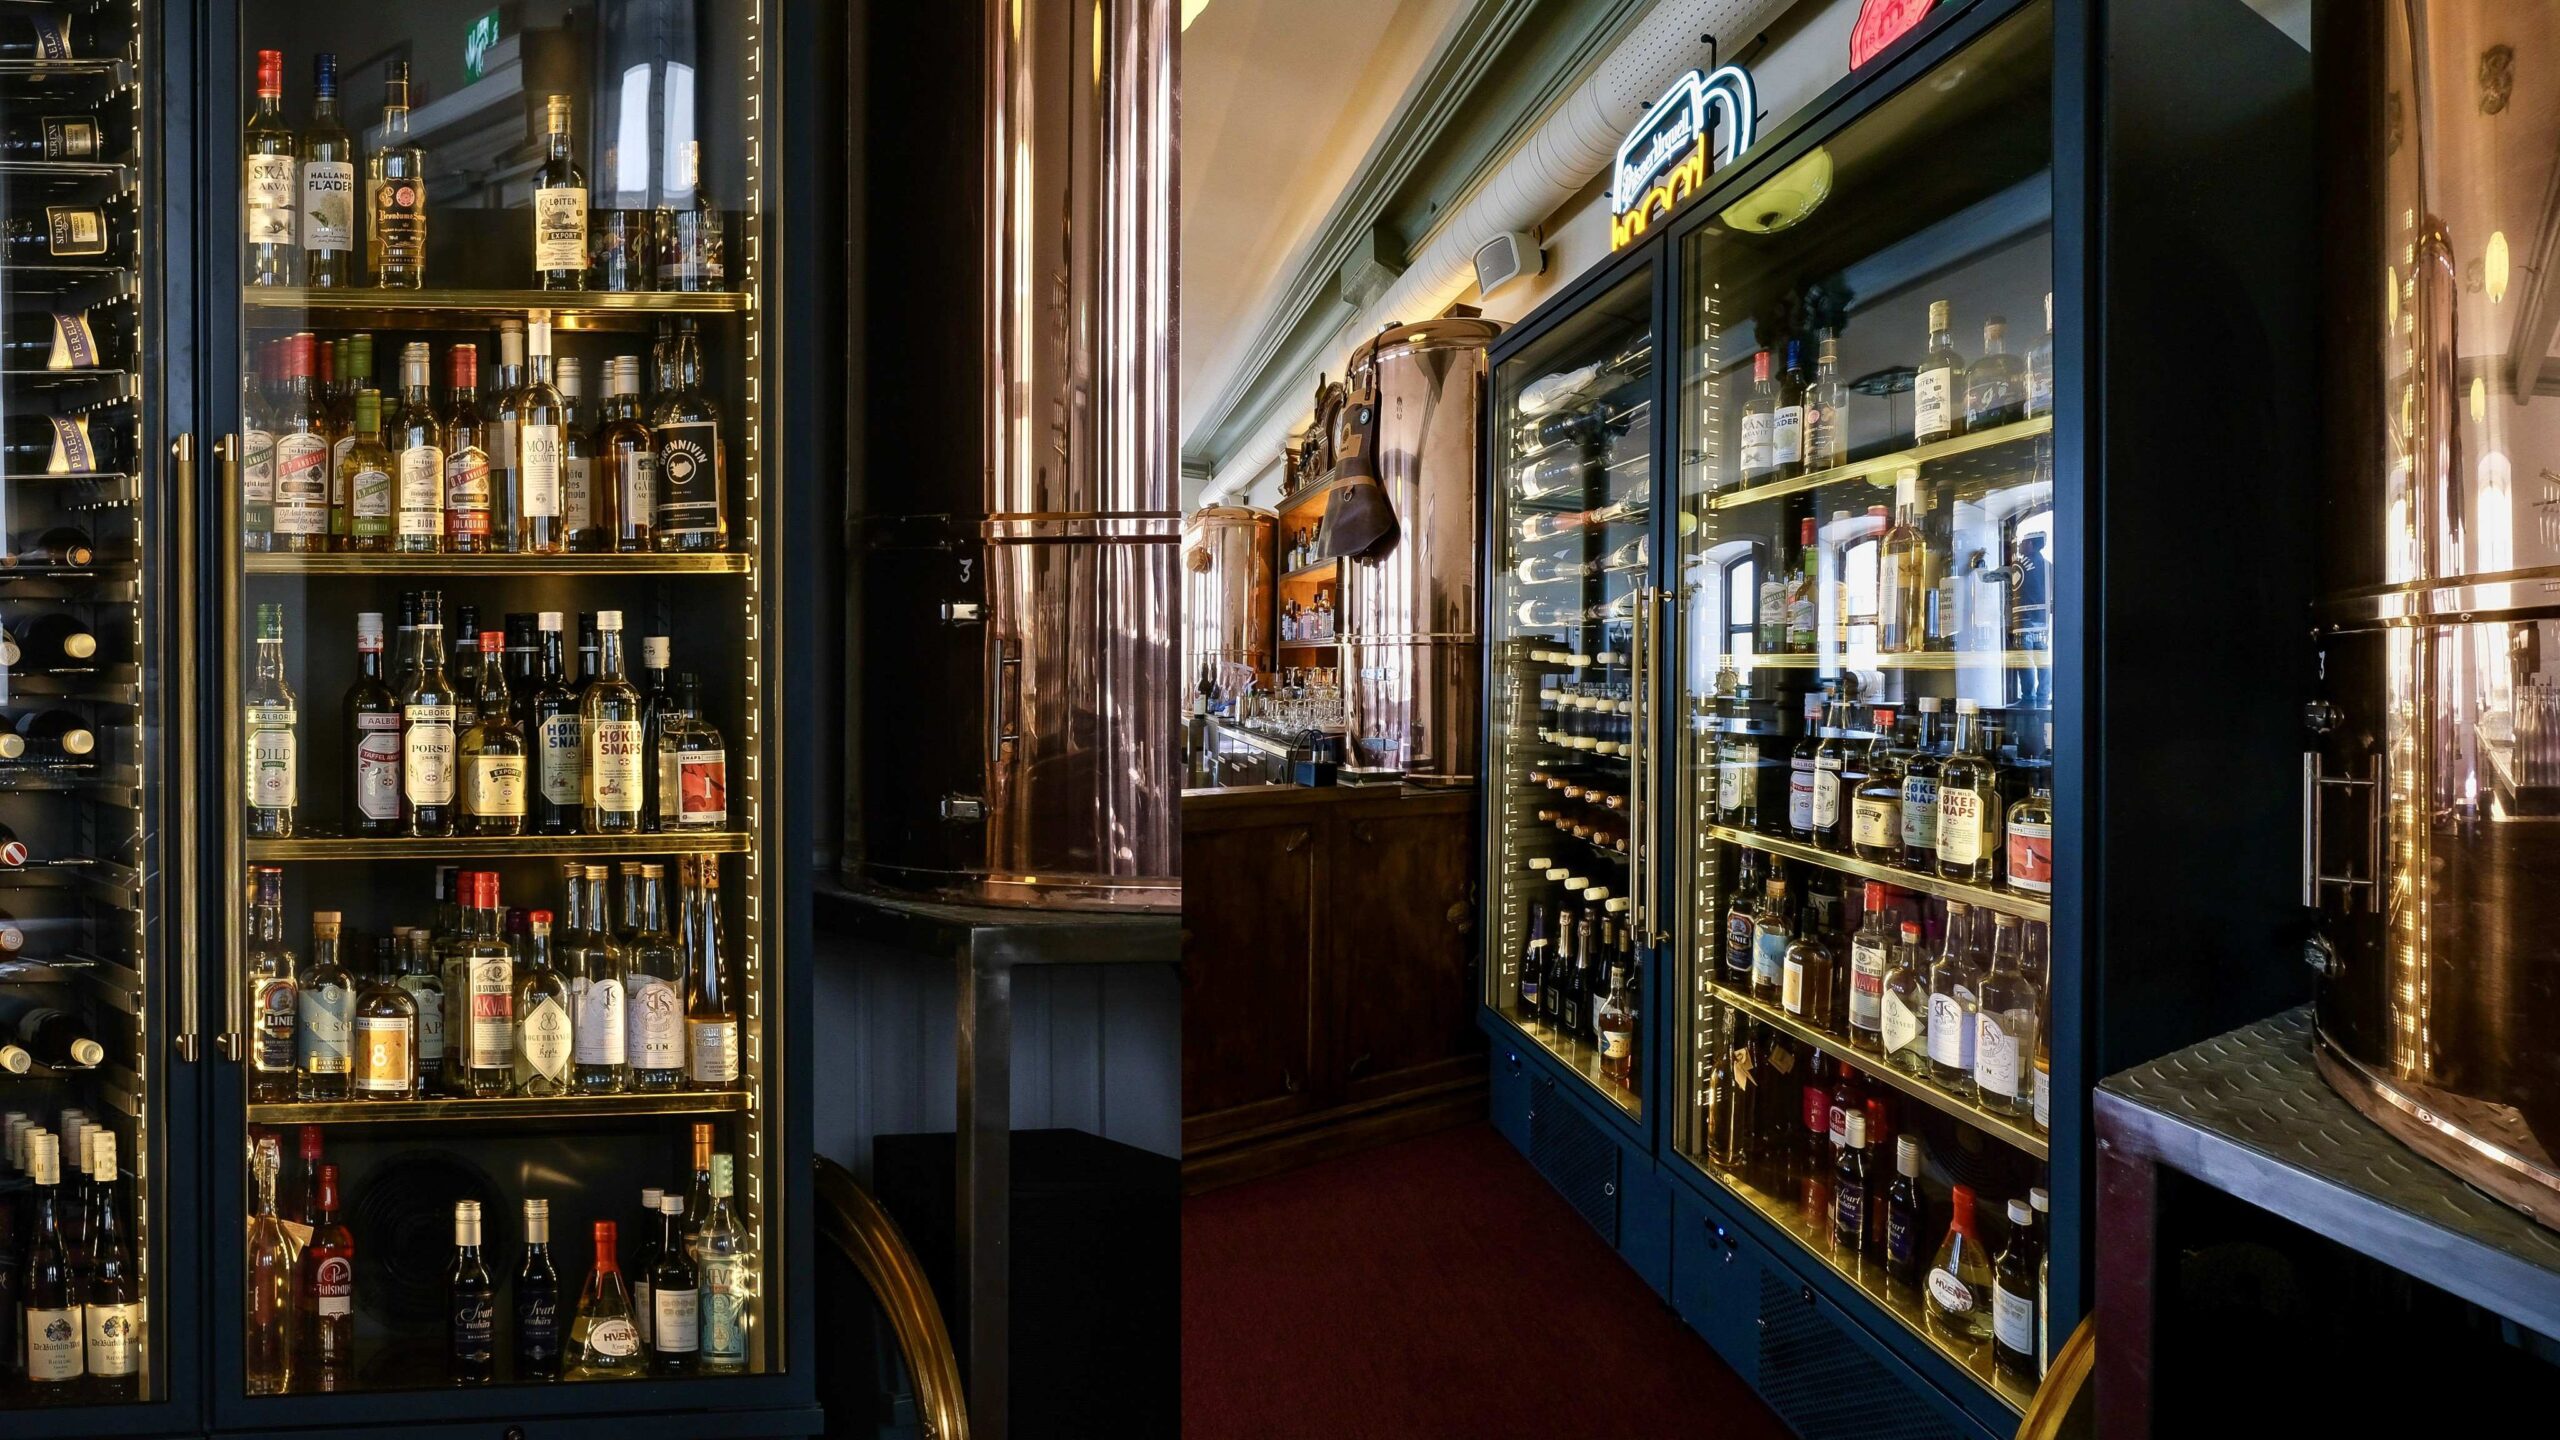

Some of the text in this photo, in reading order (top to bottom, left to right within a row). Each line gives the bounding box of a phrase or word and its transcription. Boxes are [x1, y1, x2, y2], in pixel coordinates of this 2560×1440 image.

[308, 180, 352, 192] FLÄDER
[549, 197, 577, 206] LØITEN
[55, 212, 65, 245] SERENA
[551, 231, 578, 240] EXPORT
[246, 511, 262, 523] DILL
[958, 557, 973, 584] 3
[255, 748, 291, 760] DILD
[411, 744, 451, 753] PORSE
[704, 776, 713, 799] 1
[2024, 848, 2034, 869] 1
[267, 1015, 294, 1026] LINIE
[371, 1044, 388, 1067] 8
[459, 1301, 494, 1321] Svart
